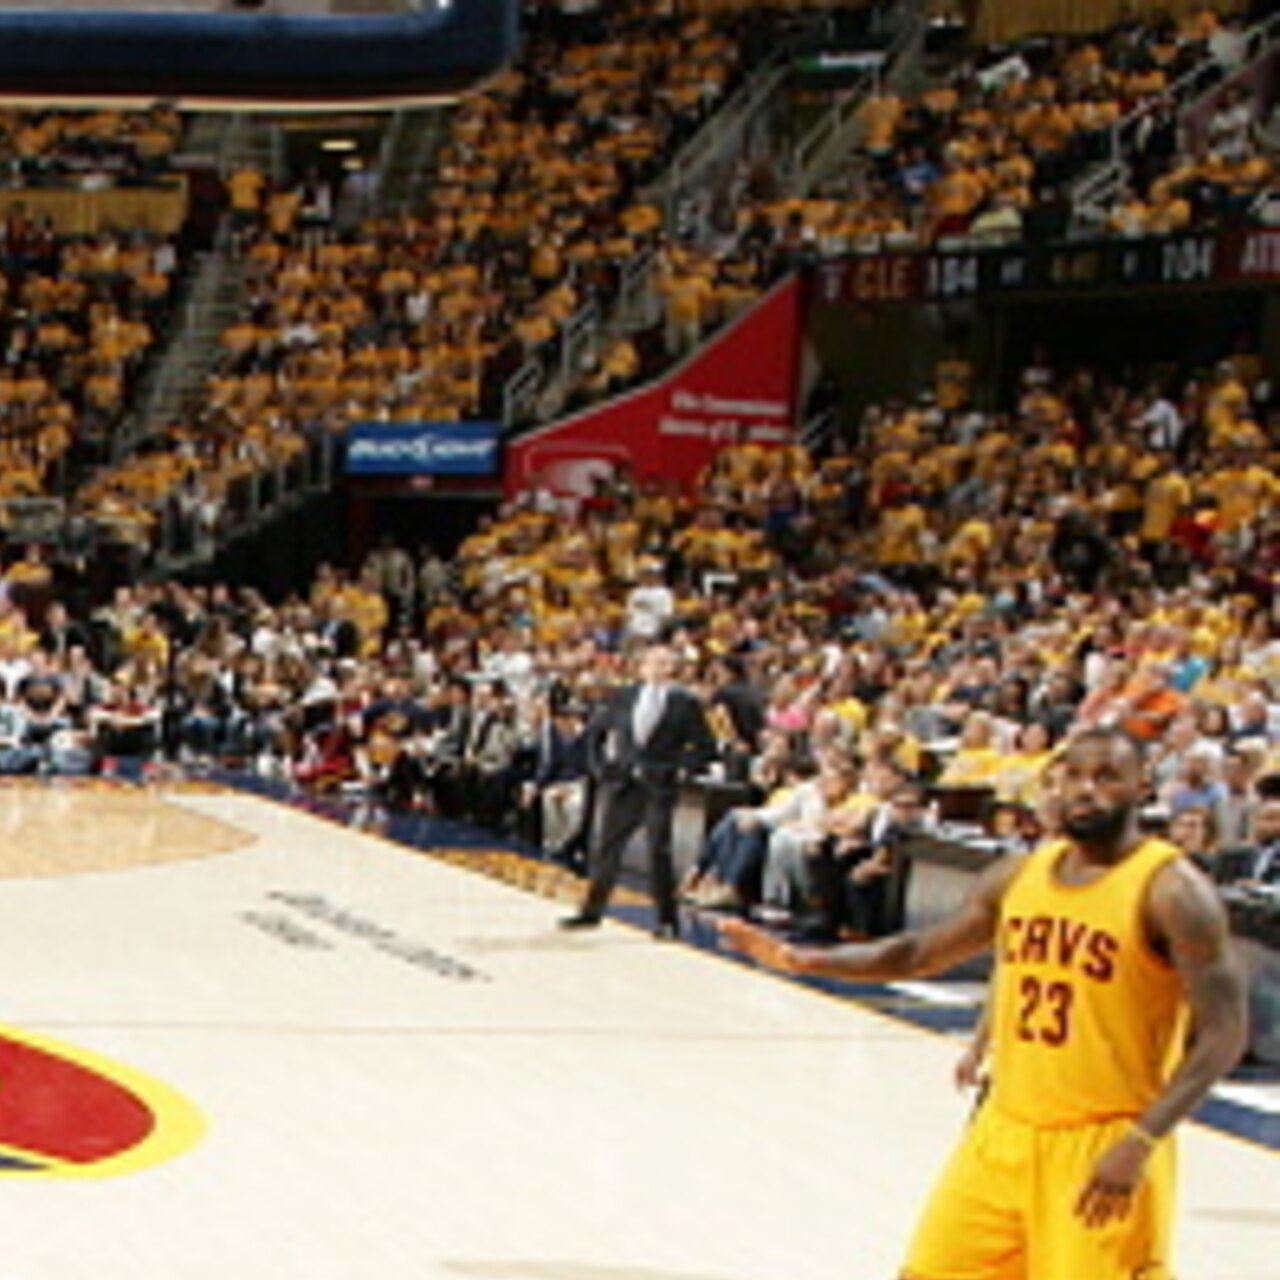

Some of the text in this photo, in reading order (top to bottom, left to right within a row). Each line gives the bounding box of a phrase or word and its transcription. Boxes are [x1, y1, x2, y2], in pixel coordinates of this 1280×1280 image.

[851, 255, 912, 300] CLE
[1001, 916, 1120, 984] CAVS
[1016, 974, 1074, 1047] 23
